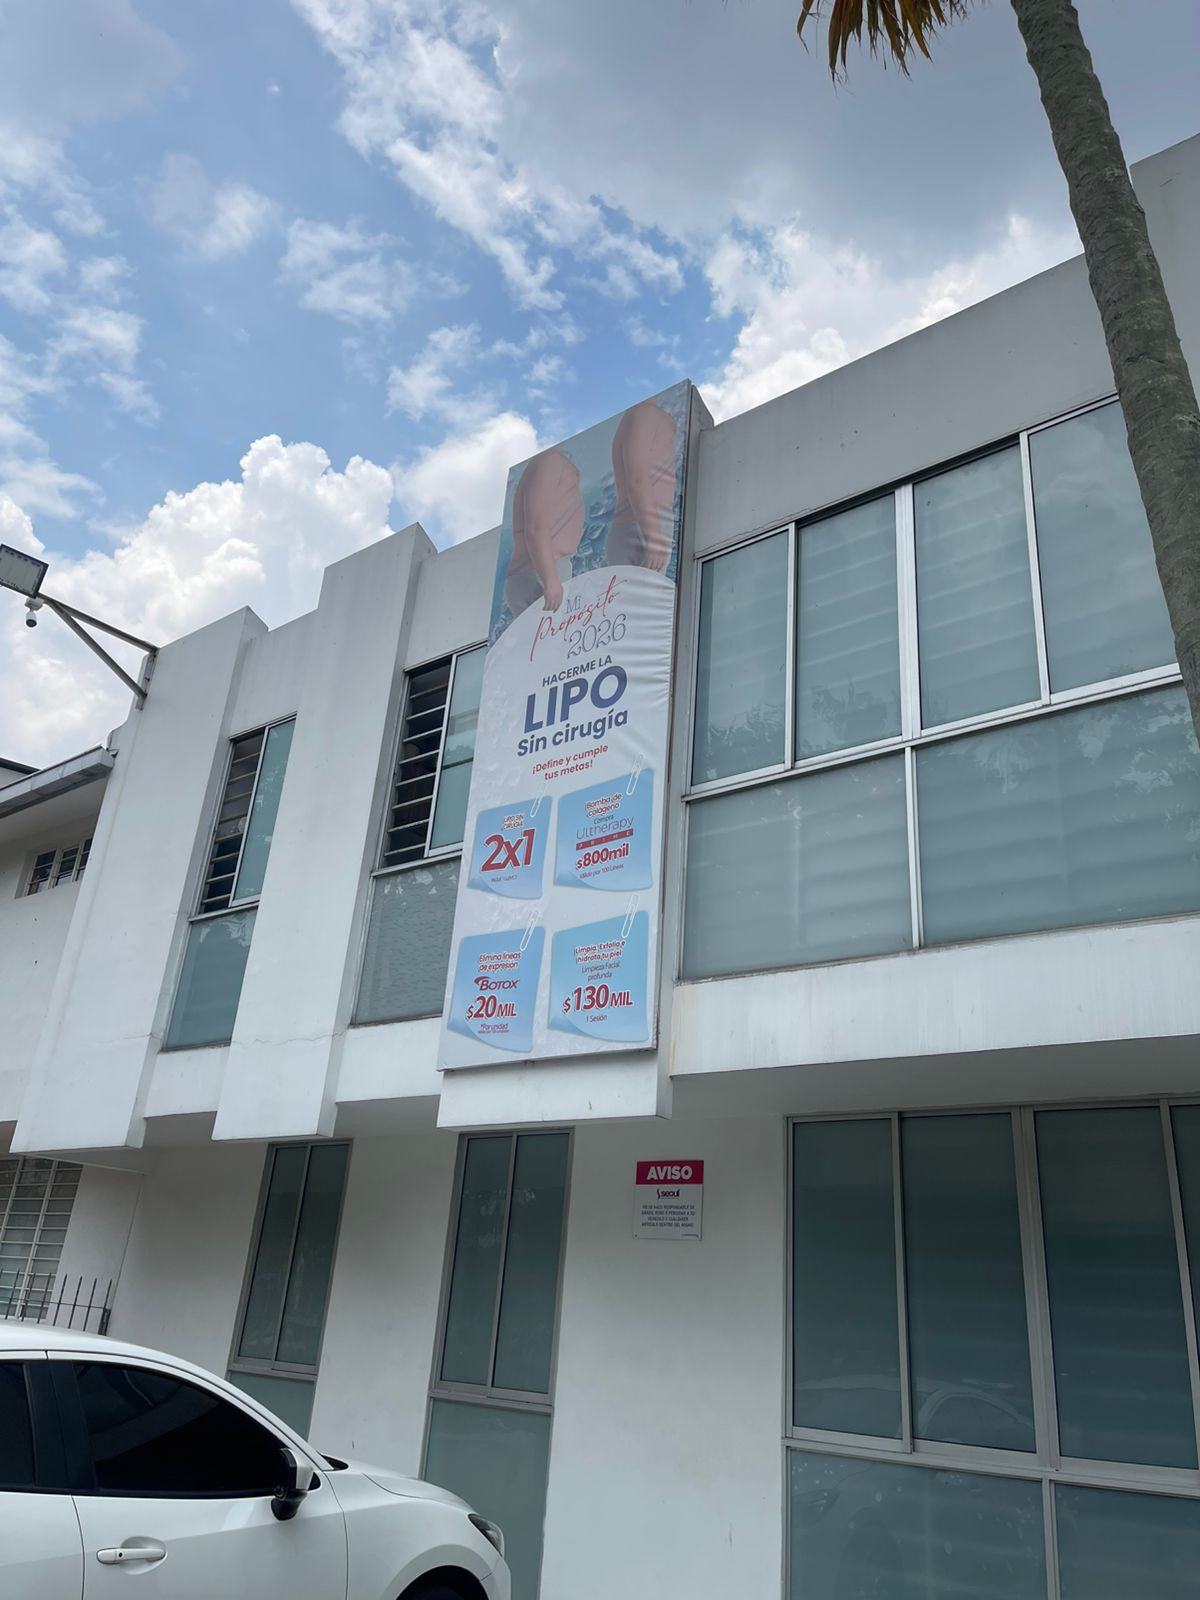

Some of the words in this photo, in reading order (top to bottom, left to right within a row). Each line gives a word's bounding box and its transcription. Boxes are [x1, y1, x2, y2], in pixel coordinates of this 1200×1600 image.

[567, 613, 626, 659] 2026
[542, 660, 596, 687] HACERME
[599, 655, 613, 667] LA
[524, 665, 628, 734] LIPO
[552, 709, 629, 739] cirugía
[532, 758, 564, 774] ¡Define
[565, 755, 572, 766] y
[573, 744, 609, 761] cumple
[544, 771, 559, 780] tus
[560, 759, 593, 776] metas!
[586, 797, 611, 809] Bomba
[612, 793, 622, 802] de
[576, 816, 634, 840] Ultherapy
[481, 828, 536, 872] 2x1
[479, 954, 501, 962] Elimina
[576, 953, 601, 962] hidrata
[609, 950, 622, 959] piel
[646, 1165, 693, 1180] AVISO
